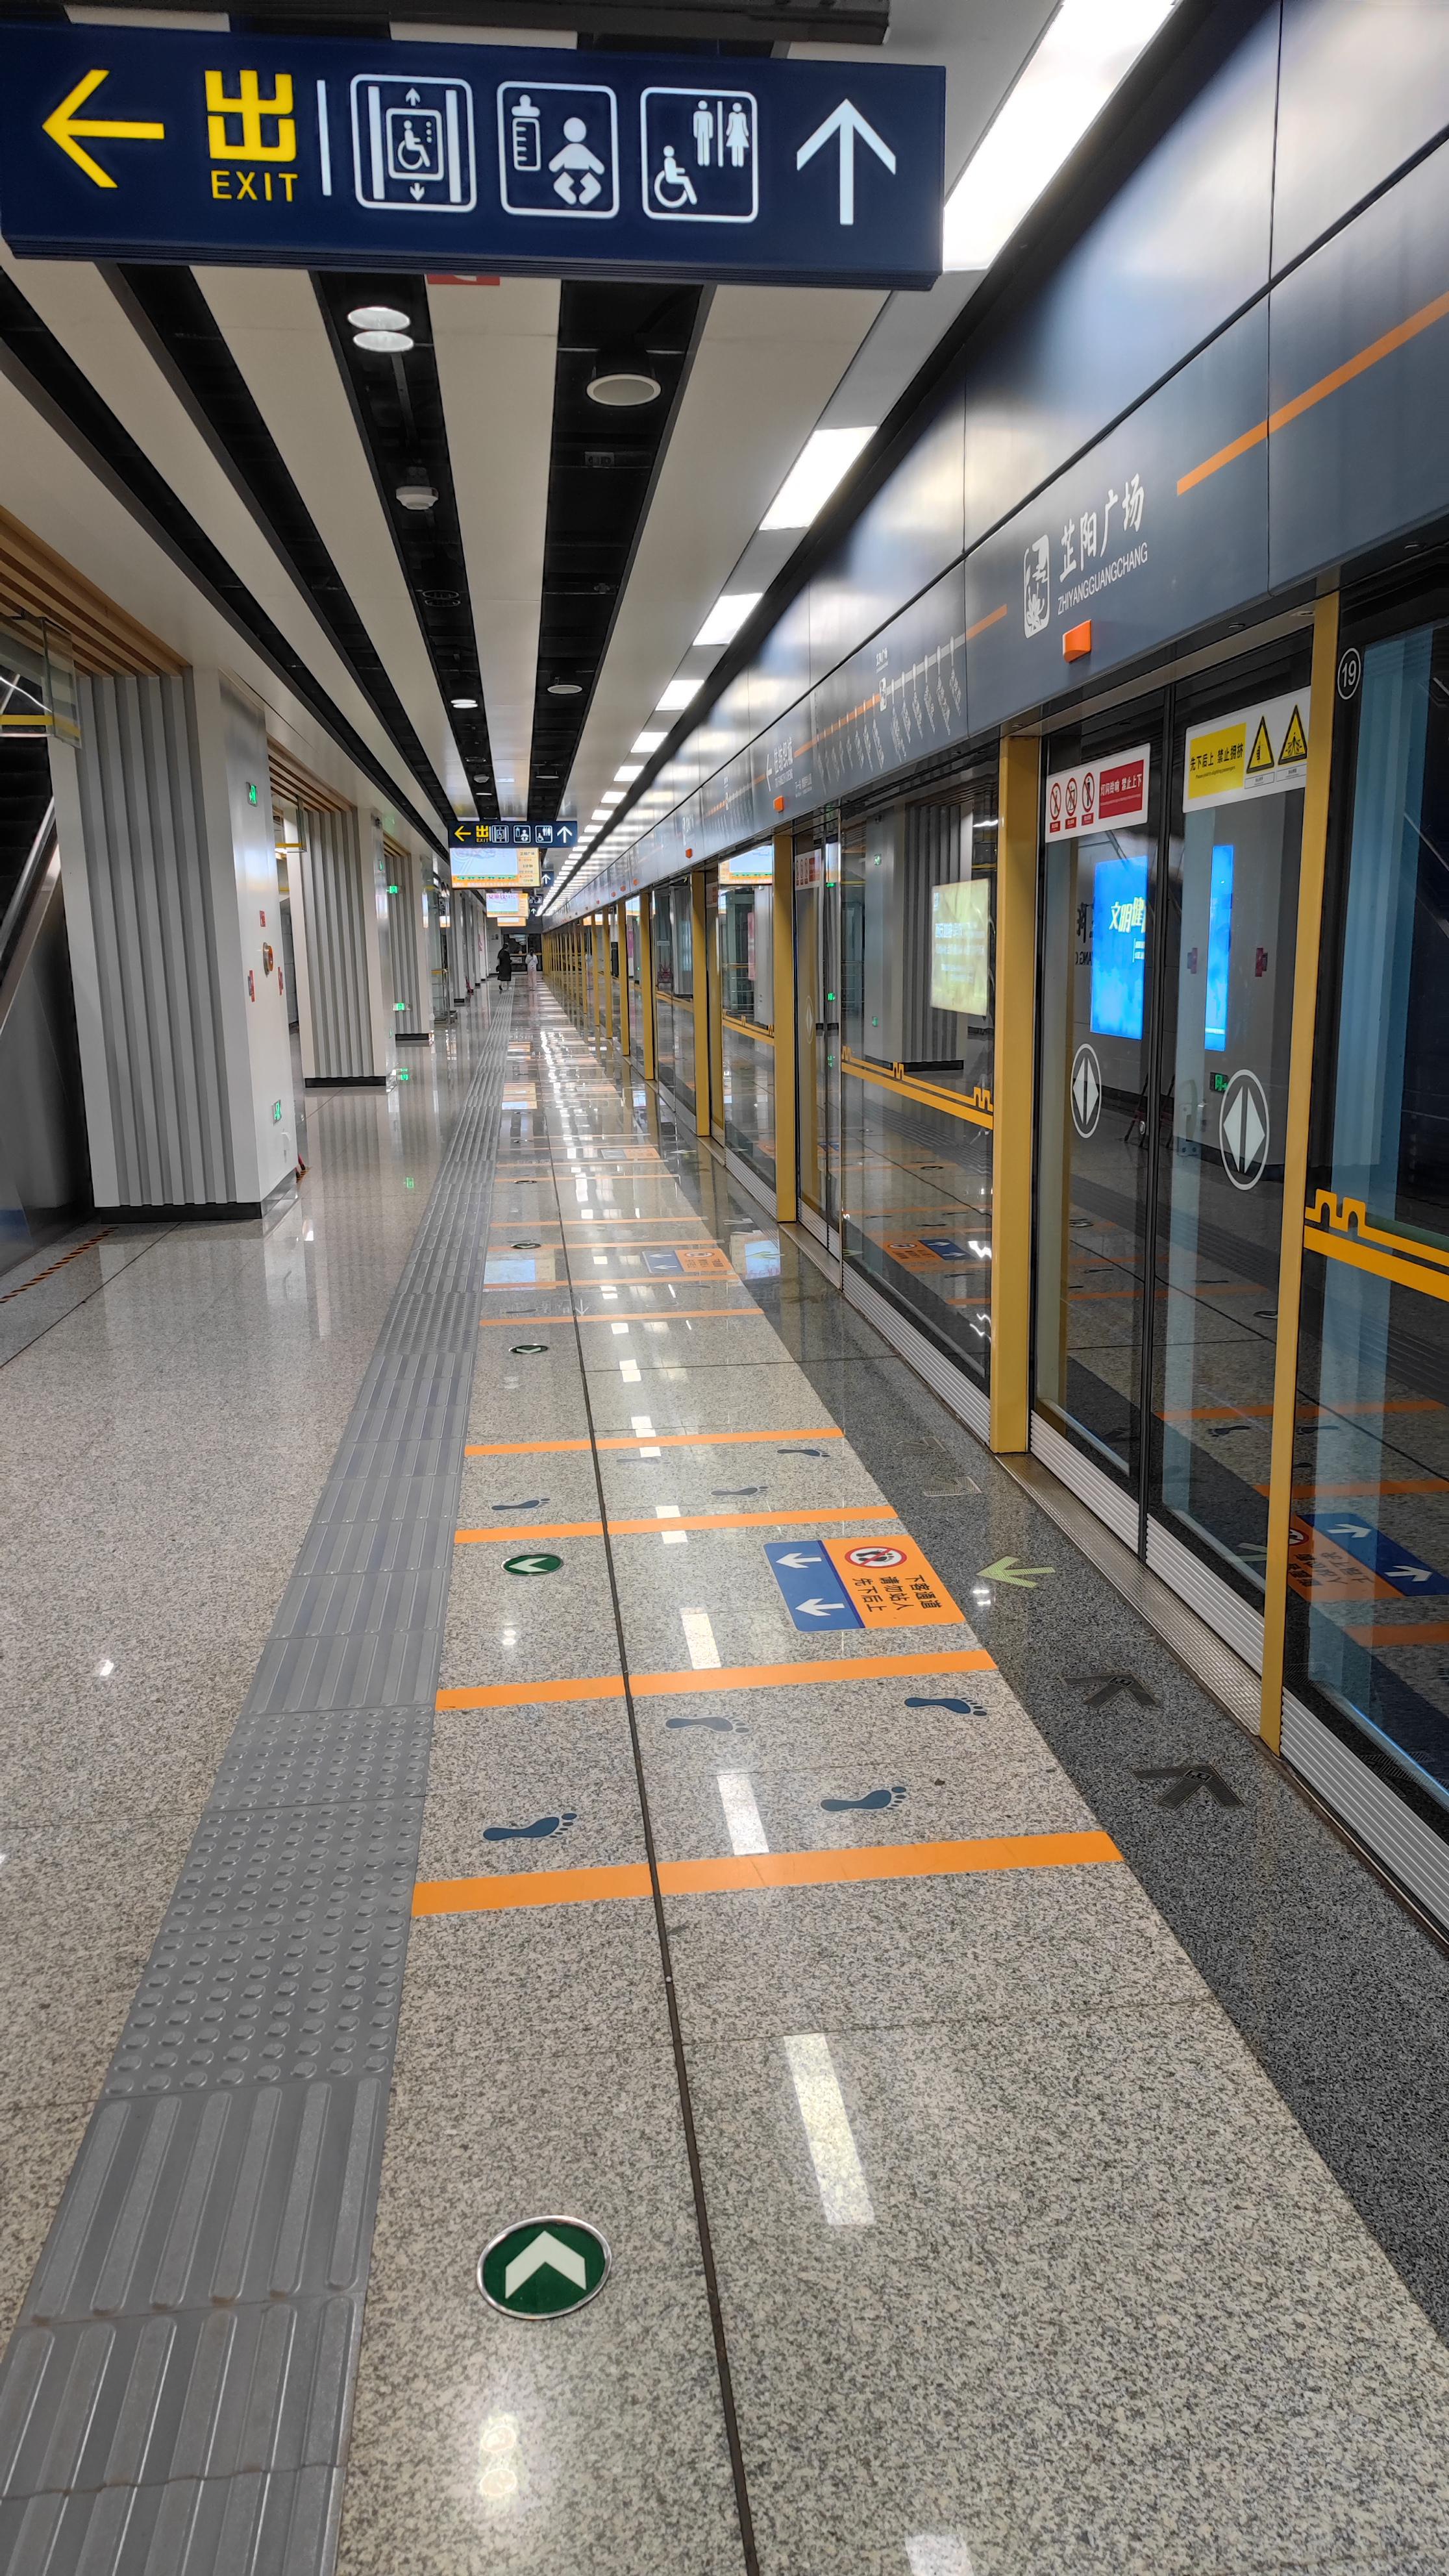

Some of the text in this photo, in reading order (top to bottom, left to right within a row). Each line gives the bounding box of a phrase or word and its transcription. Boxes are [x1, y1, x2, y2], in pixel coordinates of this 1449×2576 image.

[204, 69, 297, 162] 出
[211, 170, 299, 202] EXIT
[1059, 473, 1145, 583] 芷阳广场
[1058, 541, 1148, 615] ZHIYANGGUANGCHANG
[1341, 660, 1357, 688] 19
[1190, 750, 1214, 771] 先下后上
[1109, 897, 1146, 934] 文明健
[852, 1578, 887, 1613] 先下后上
[880, 1576, 915, 1611] 请勿站人
[905, 1574, 943, 1609] 下客通道
